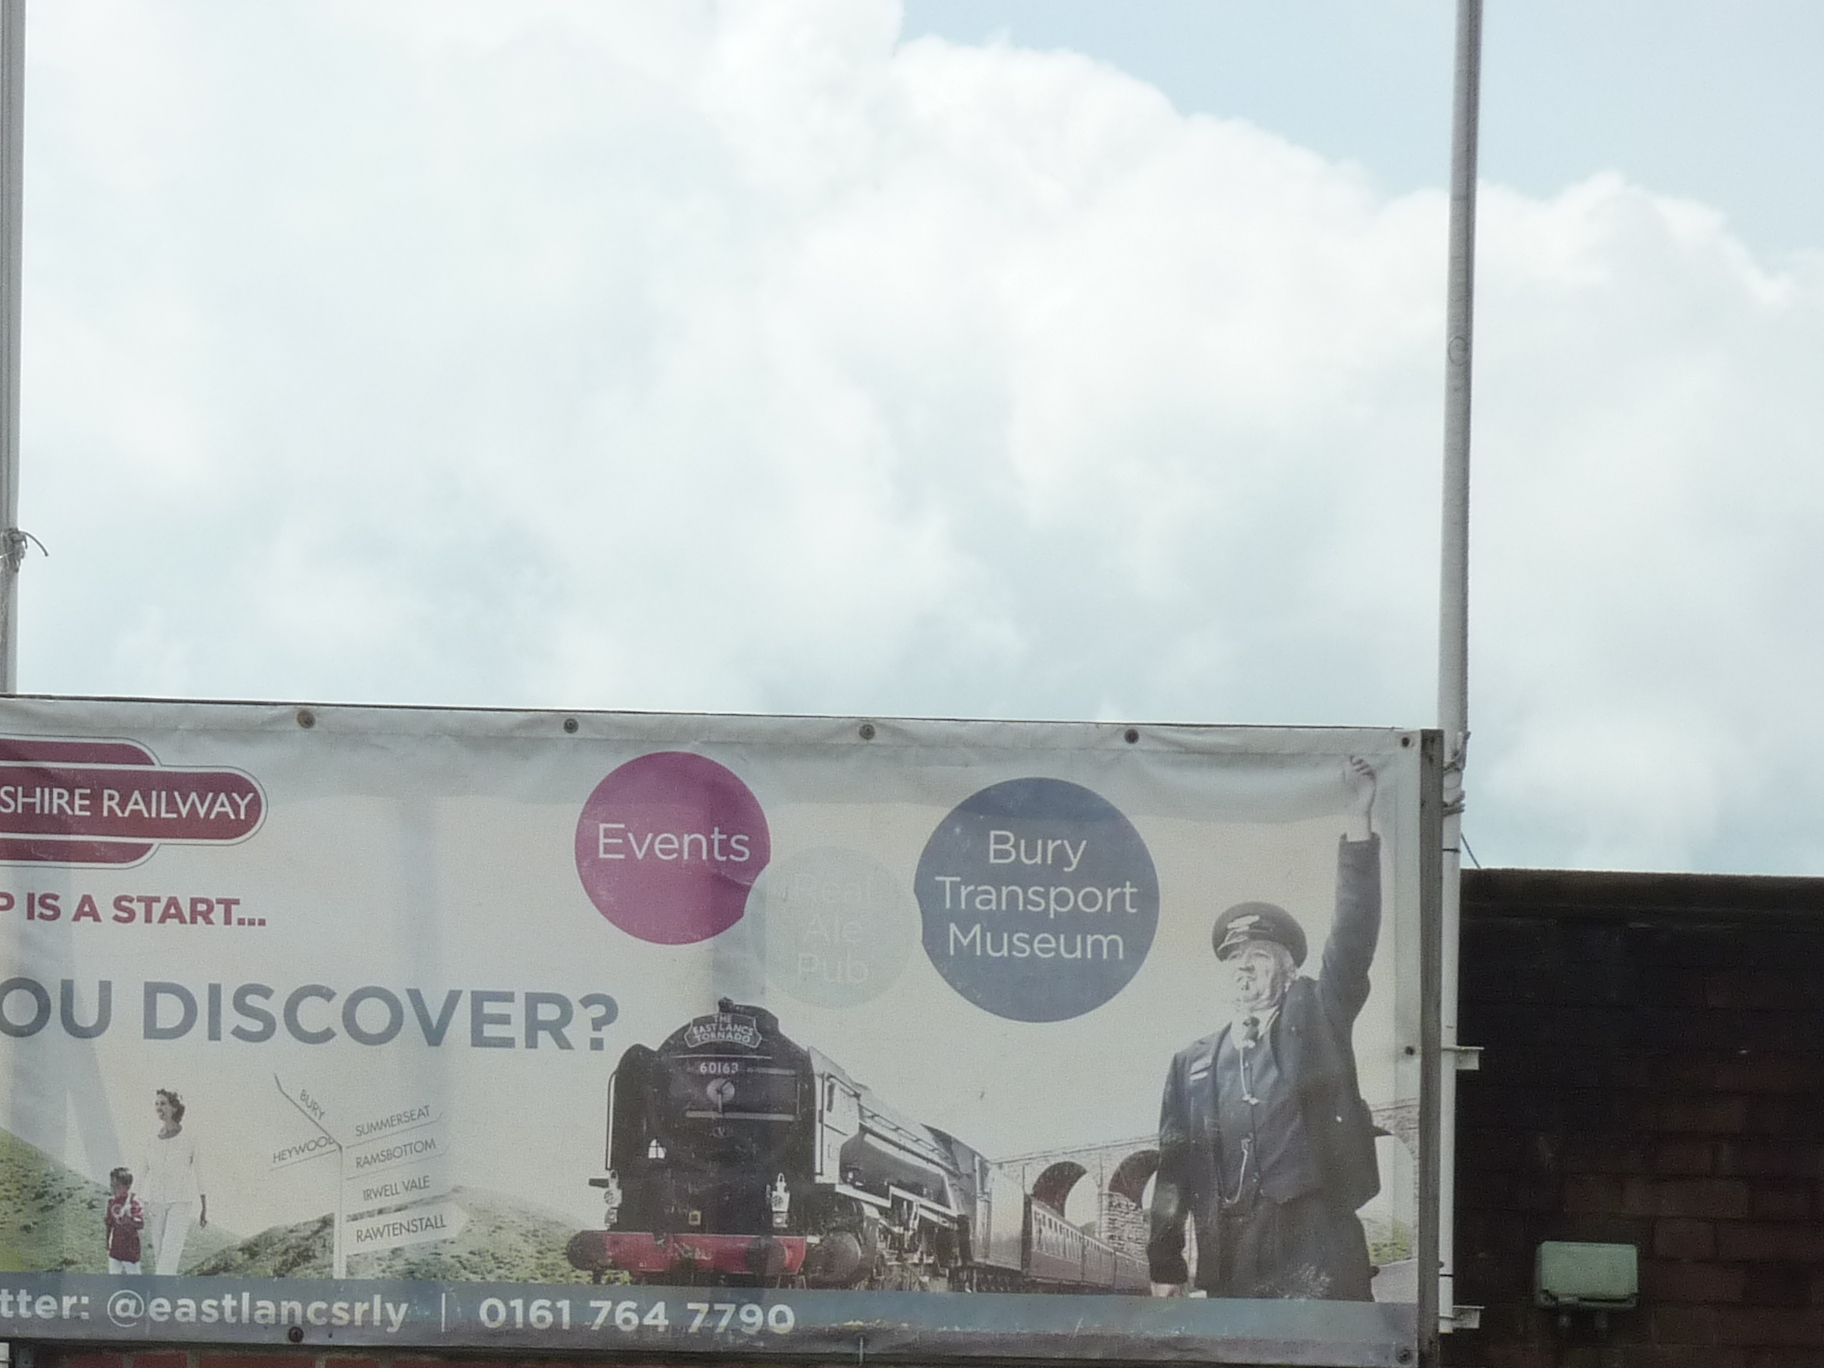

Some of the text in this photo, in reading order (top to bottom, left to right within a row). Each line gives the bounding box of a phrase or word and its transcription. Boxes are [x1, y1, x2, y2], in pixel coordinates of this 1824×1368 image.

[102, 789, 255, 821] RAILWAY
[598, 823, 752, 862] Events
[988, 829, 1088, 872] Bury
[26, 892, 62, 922] IS
[71, 893, 103, 923] A
[110, 895, 267, 928] START...
[935, 876, 1138, 919] Transport
[948, 923, 1125, 961] Museum
[142, 979, 620, 1052] DISCOVER?
[699, 1062, 739, 1074] 60163
[299, 1089, 326, 1121] BURY
[354, 1104, 431, 1138] SUMMERSEAT
[272, 1135, 335, 1165] HEYWOOD
[355, 1137, 437, 1170] RAMSBOTTOM
[362, 1174, 430, 1202] IRWELL VALE
[356, 1213, 447, 1244] RAWTENSTALL
[106, 1289, 409, 1333] @eastlancsrly
[479, 1297, 572, 1330] 0161
[589, 1300, 670, 1332] 764
[686, 1302, 796, 1335] 7790
